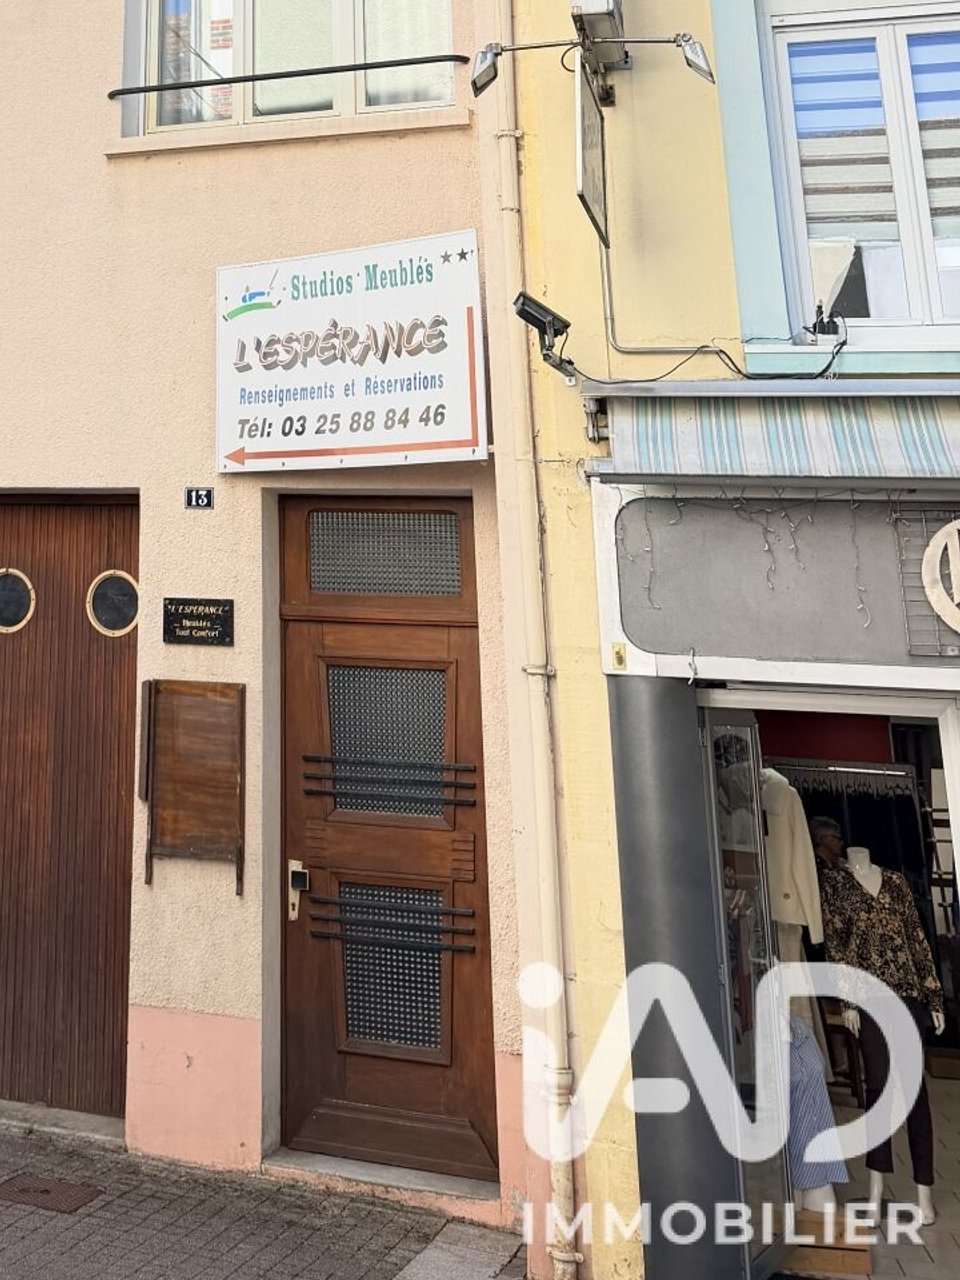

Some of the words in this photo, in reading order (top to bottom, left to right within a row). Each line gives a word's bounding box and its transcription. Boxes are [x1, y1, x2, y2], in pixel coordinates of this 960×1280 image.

[290, 271, 353, 301] Studios
[364, 256, 434, 291] Meublés
[233, 315, 448, 373] L'ESPÉRANCE
[239, 381, 335, 408] Renseignements
[344, 379, 356, 397] et
[365, 371, 444, 396] Réservations
[238, 417, 273, 439] Tél:
[281, 415, 307, 437] 03
[315, 413, 341, 435] 25
[349, 410, 375, 433] 88
[383, 407, 410, 431] 84
[419, 404, 446, 427] 46
[190, 490, 208, 506] 13
